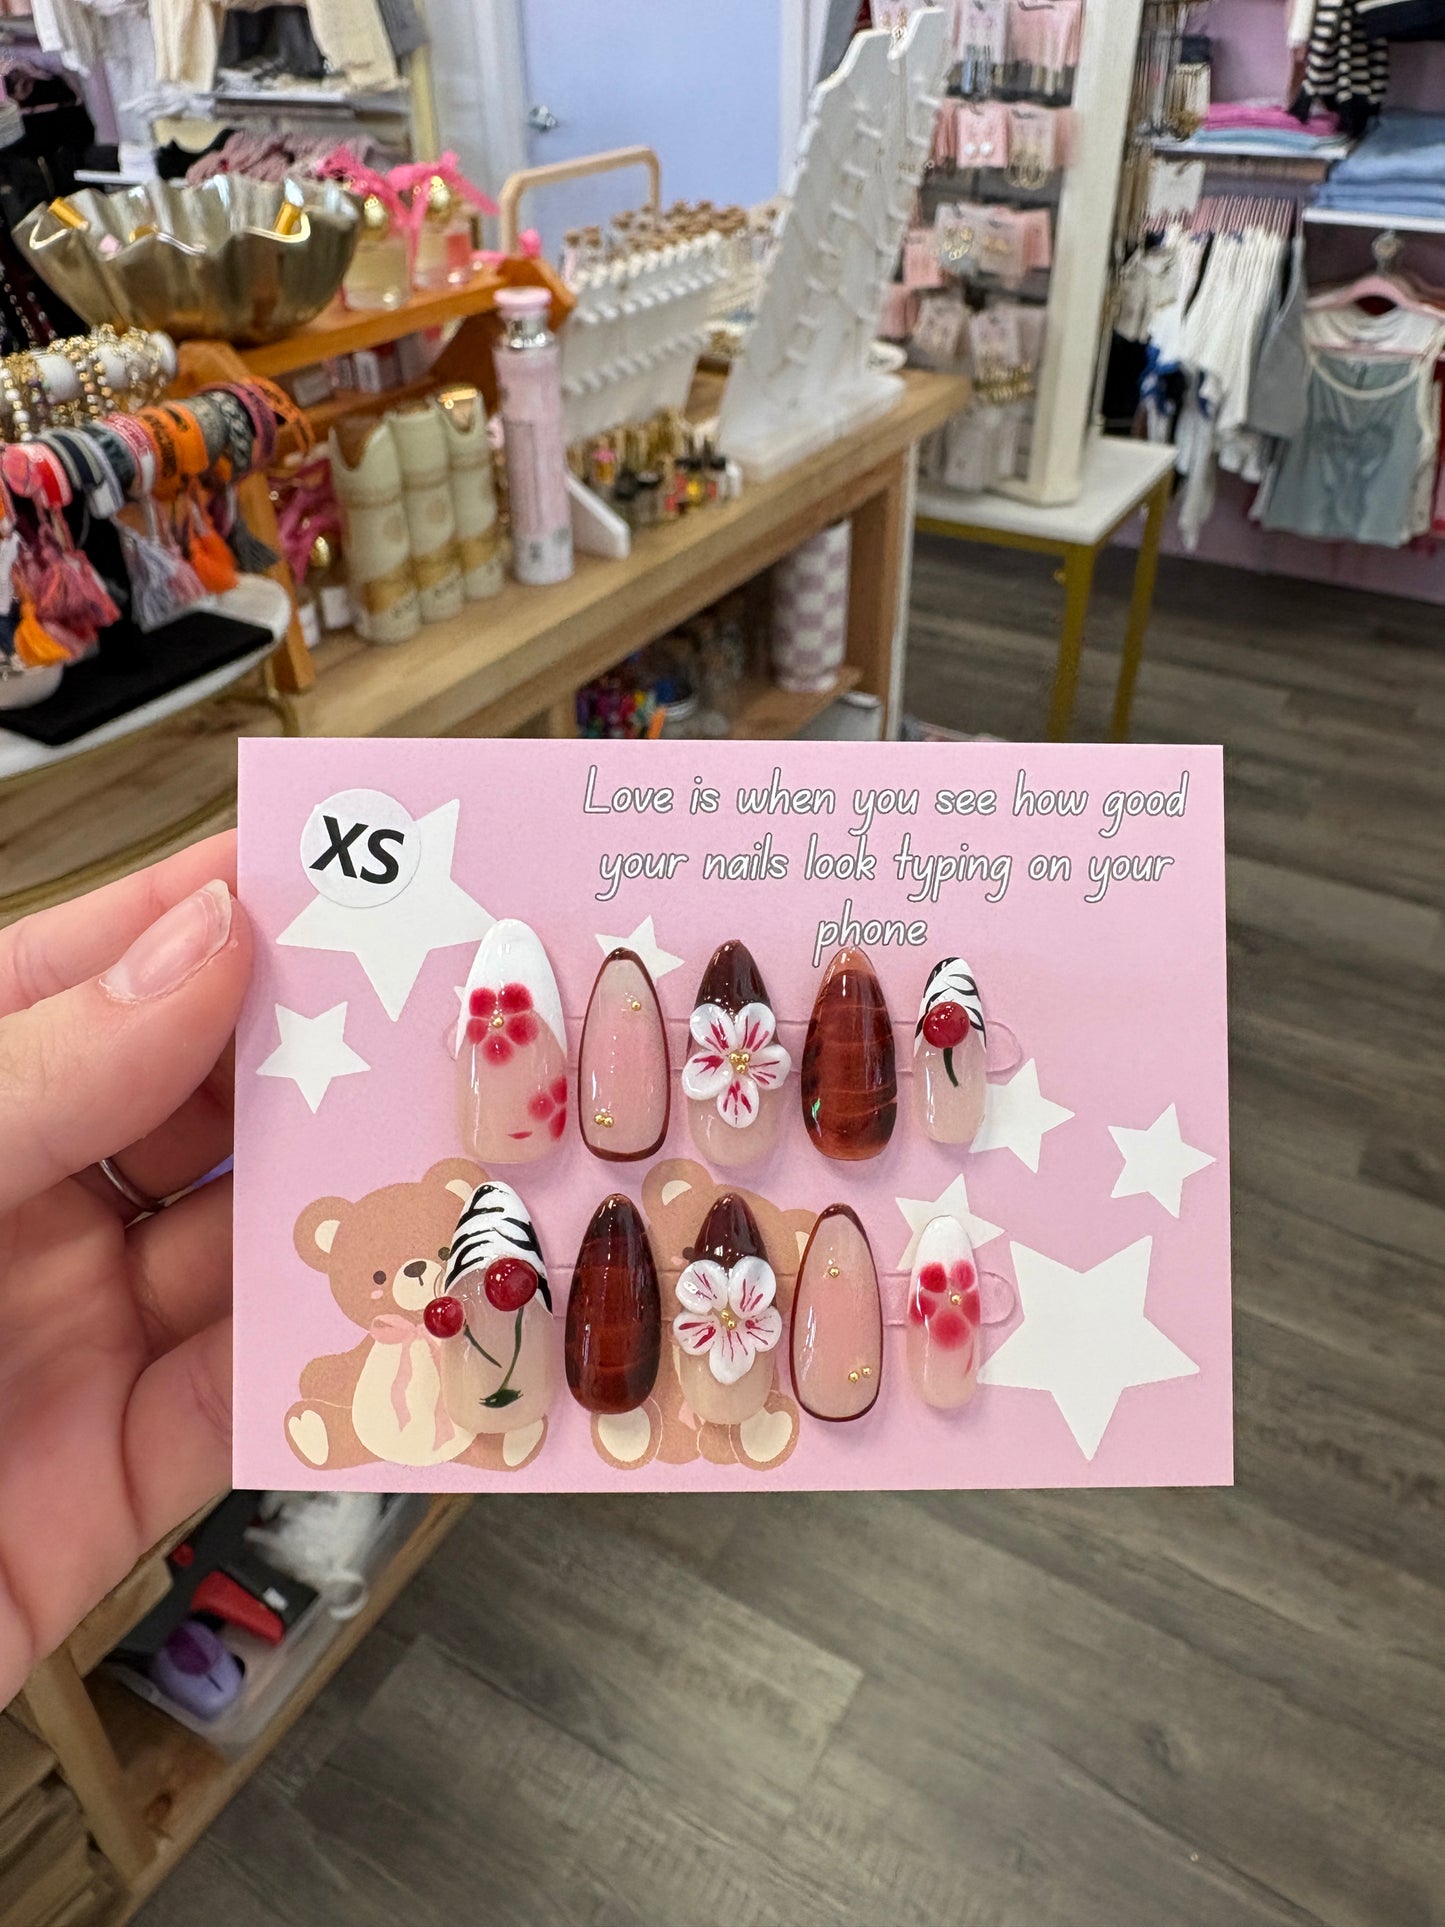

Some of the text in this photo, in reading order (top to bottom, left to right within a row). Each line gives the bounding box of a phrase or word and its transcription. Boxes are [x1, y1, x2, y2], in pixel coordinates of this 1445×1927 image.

[583, 764, 1190, 839] Love is when you see how good
[309, 815, 405, 884] XS
[595, 832, 1174, 903] your nails look typing on your
[812, 898, 928, 968] phone
